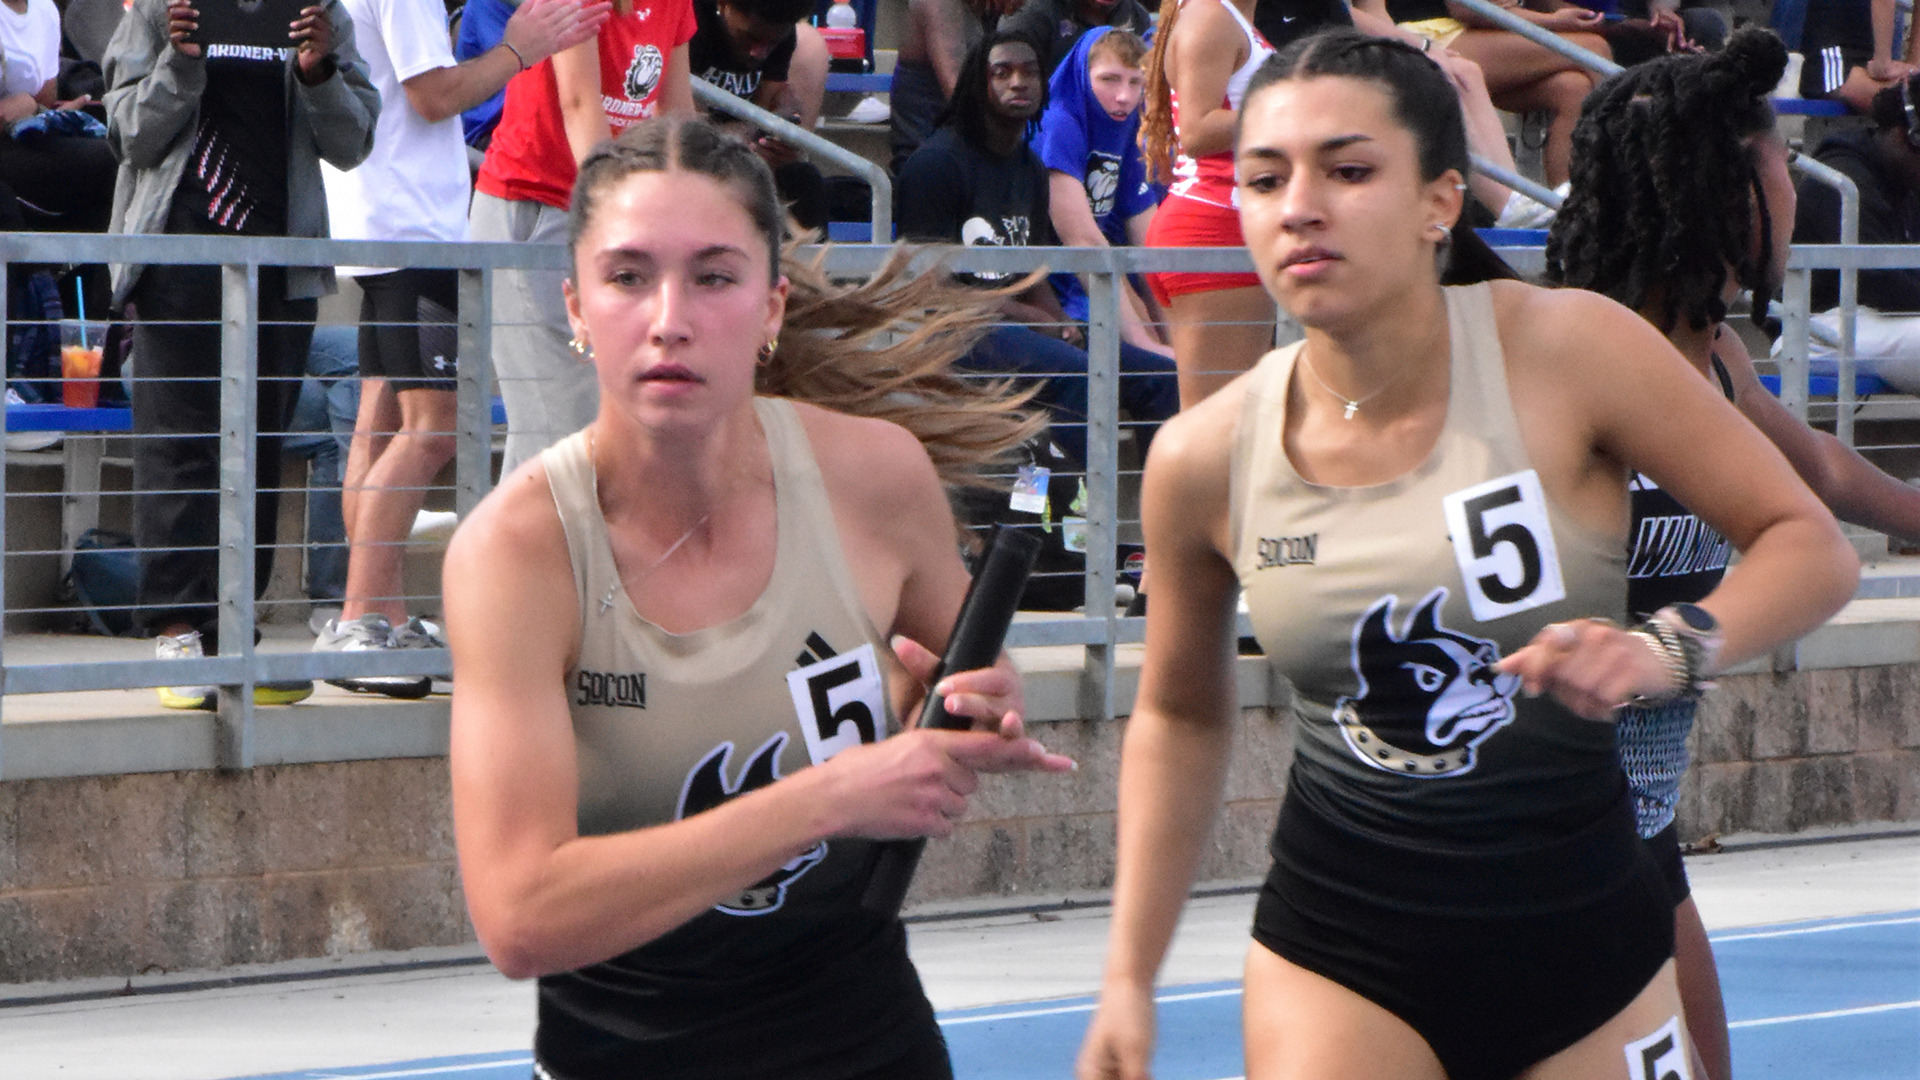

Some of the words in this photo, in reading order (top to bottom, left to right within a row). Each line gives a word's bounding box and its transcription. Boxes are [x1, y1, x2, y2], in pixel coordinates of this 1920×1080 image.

[1256, 533, 1318, 570] SOCON
[1464, 484, 1541, 604] 5
[577, 669, 646, 709] SOCON
[807, 660, 876, 748] 5
